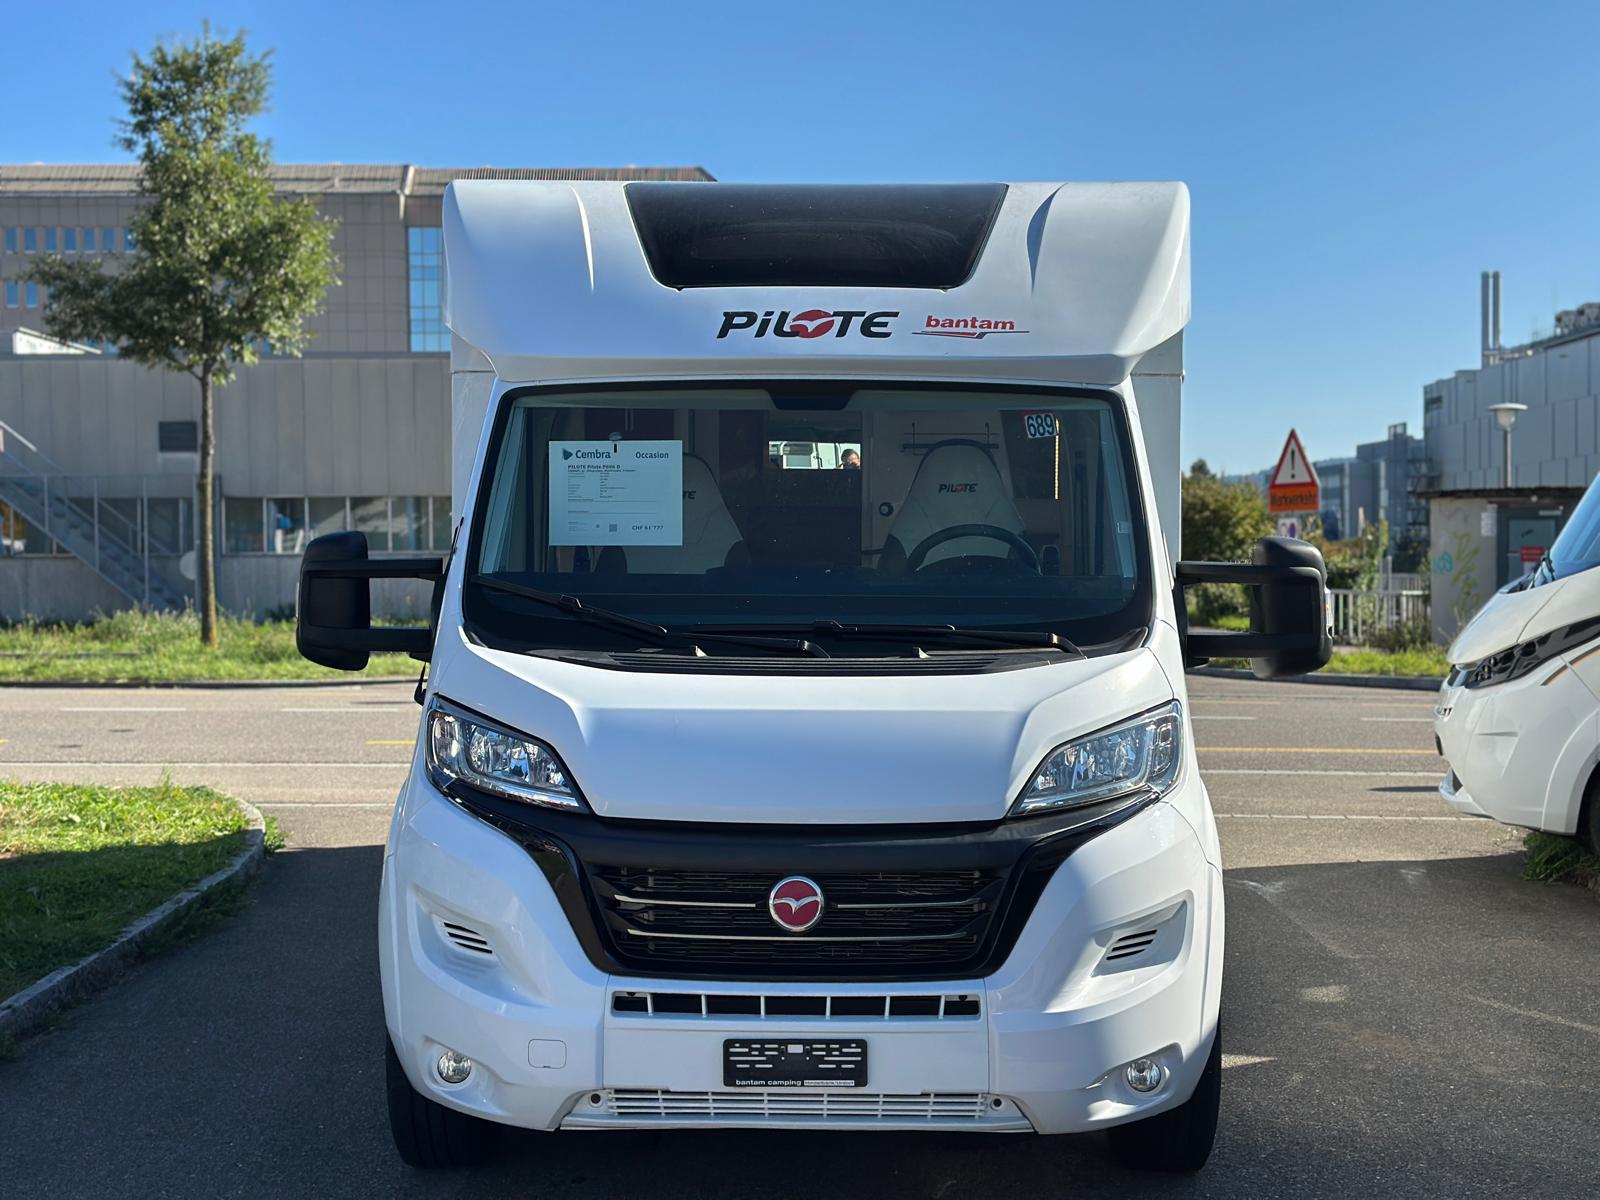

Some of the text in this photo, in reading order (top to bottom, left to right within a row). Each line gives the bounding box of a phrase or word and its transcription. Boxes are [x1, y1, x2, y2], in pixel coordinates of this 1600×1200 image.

[924, 315, 1016, 330] bantam
[1027, 414, 1055, 437] 689
[575, 449, 611, 459] Cembra
[635, 451, 669, 459] Occasion
[767, 1079, 802, 1087] camping
